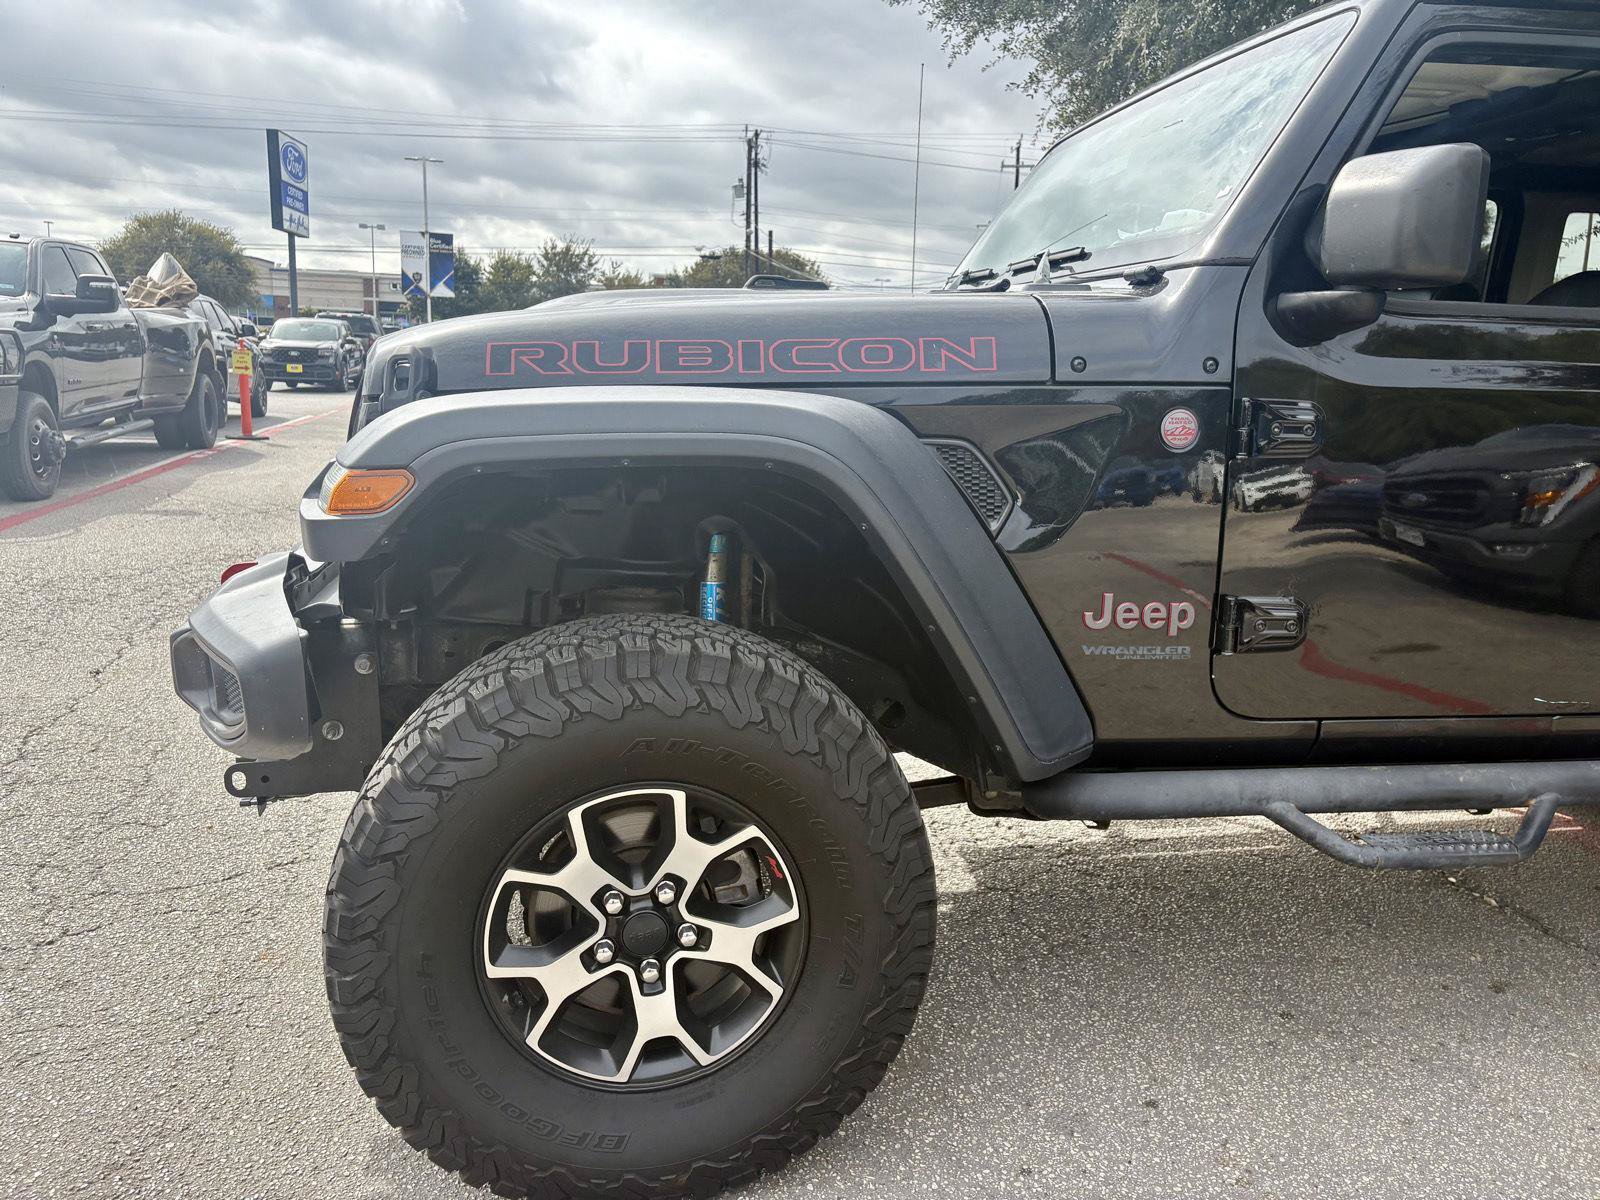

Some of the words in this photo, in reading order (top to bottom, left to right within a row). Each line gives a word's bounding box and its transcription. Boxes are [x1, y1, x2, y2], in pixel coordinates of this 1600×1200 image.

[485, 337, 998, 377] RUBICON
[1082, 591, 1196, 637] Jeep
[1081, 645, 1191, 655] WRANGLER
